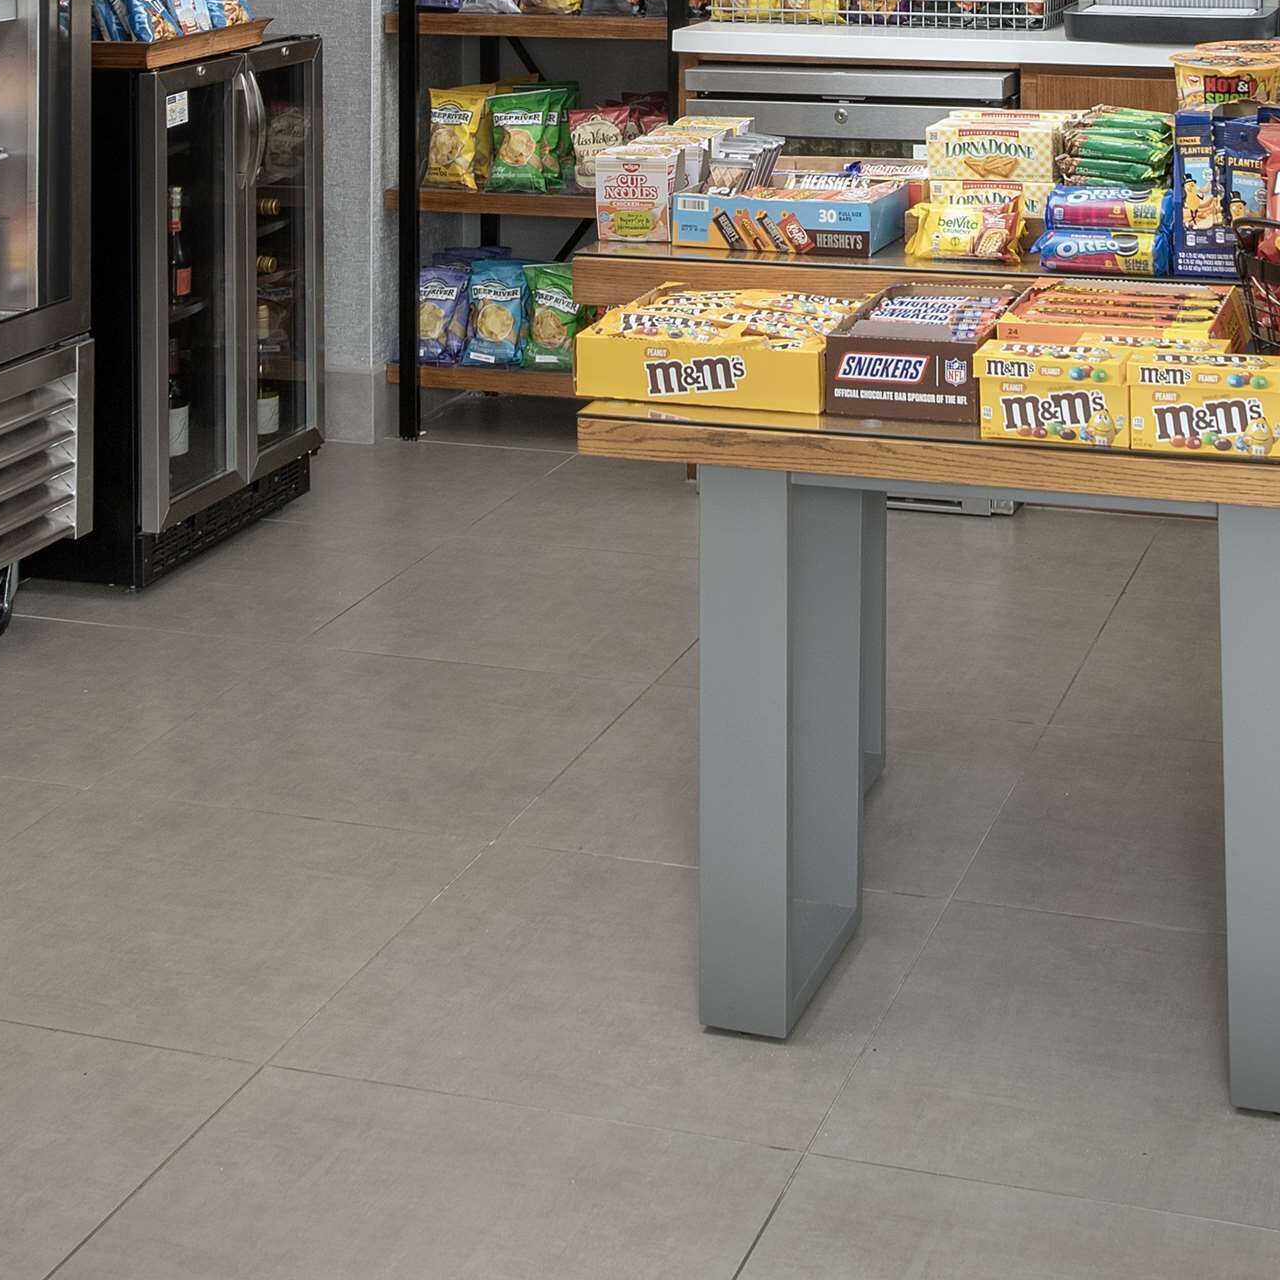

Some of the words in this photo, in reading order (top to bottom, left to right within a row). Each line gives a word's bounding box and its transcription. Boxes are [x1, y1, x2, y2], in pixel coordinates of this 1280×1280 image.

[1205, 76, 1237, 92] HOT
[1237, 81, 1250, 93] &
[447, 111, 470, 123] RIVER
[517, 113, 540, 122] RIVER
[945, 140, 987, 158] LORNA
[988, 138, 1035, 159] DOONE
[616, 174, 648, 187] CUP
[604, 186, 658, 200] NOODLES
[1067, 189, 1134, 205] OREO
[818, 209, 836, 223] 30
[937, 215, 979, 231] belVita
[816, 234, 863, 250] HERSHEY'S
[1056, 239, 1120, 257] OREO
[1124, 258, 1150, 266] KING
[431, 287, 455, 298] RIVER
[493, 287, 519, 298] RIVER
[554, 295, 579, 312] RIVER
[1007, 328, 1019, 336] 24
[646, 348, 668, 357] PEANUT
[646, 354, 746, 395] m&m's
[842, 356, 924, 380] SNICKERS
[947, 369, 965, 378] NFL
[986, 359, 1035, 378] m&m's
[1040, 367, 1061, 376] PEANUT
[1139, 366, 1192, 385] m&m's
[1197, 375, 1219, 384] PEANUT
[1002, 383, 1024, 392] PEANUT
[834, 388, 859, 399] OFFICIAL
[860, 389, 894, 401] CHOCOLATE
[894, 392, 907, 401] BAR
[908, 393, 936, 403] SPONSOR
[936, 394, 945, 403] OF
[945, 395, 956, 405] THE
[956, 395, 968, 405] NFL
[1154, 392, 1177, 402] PEANUT
